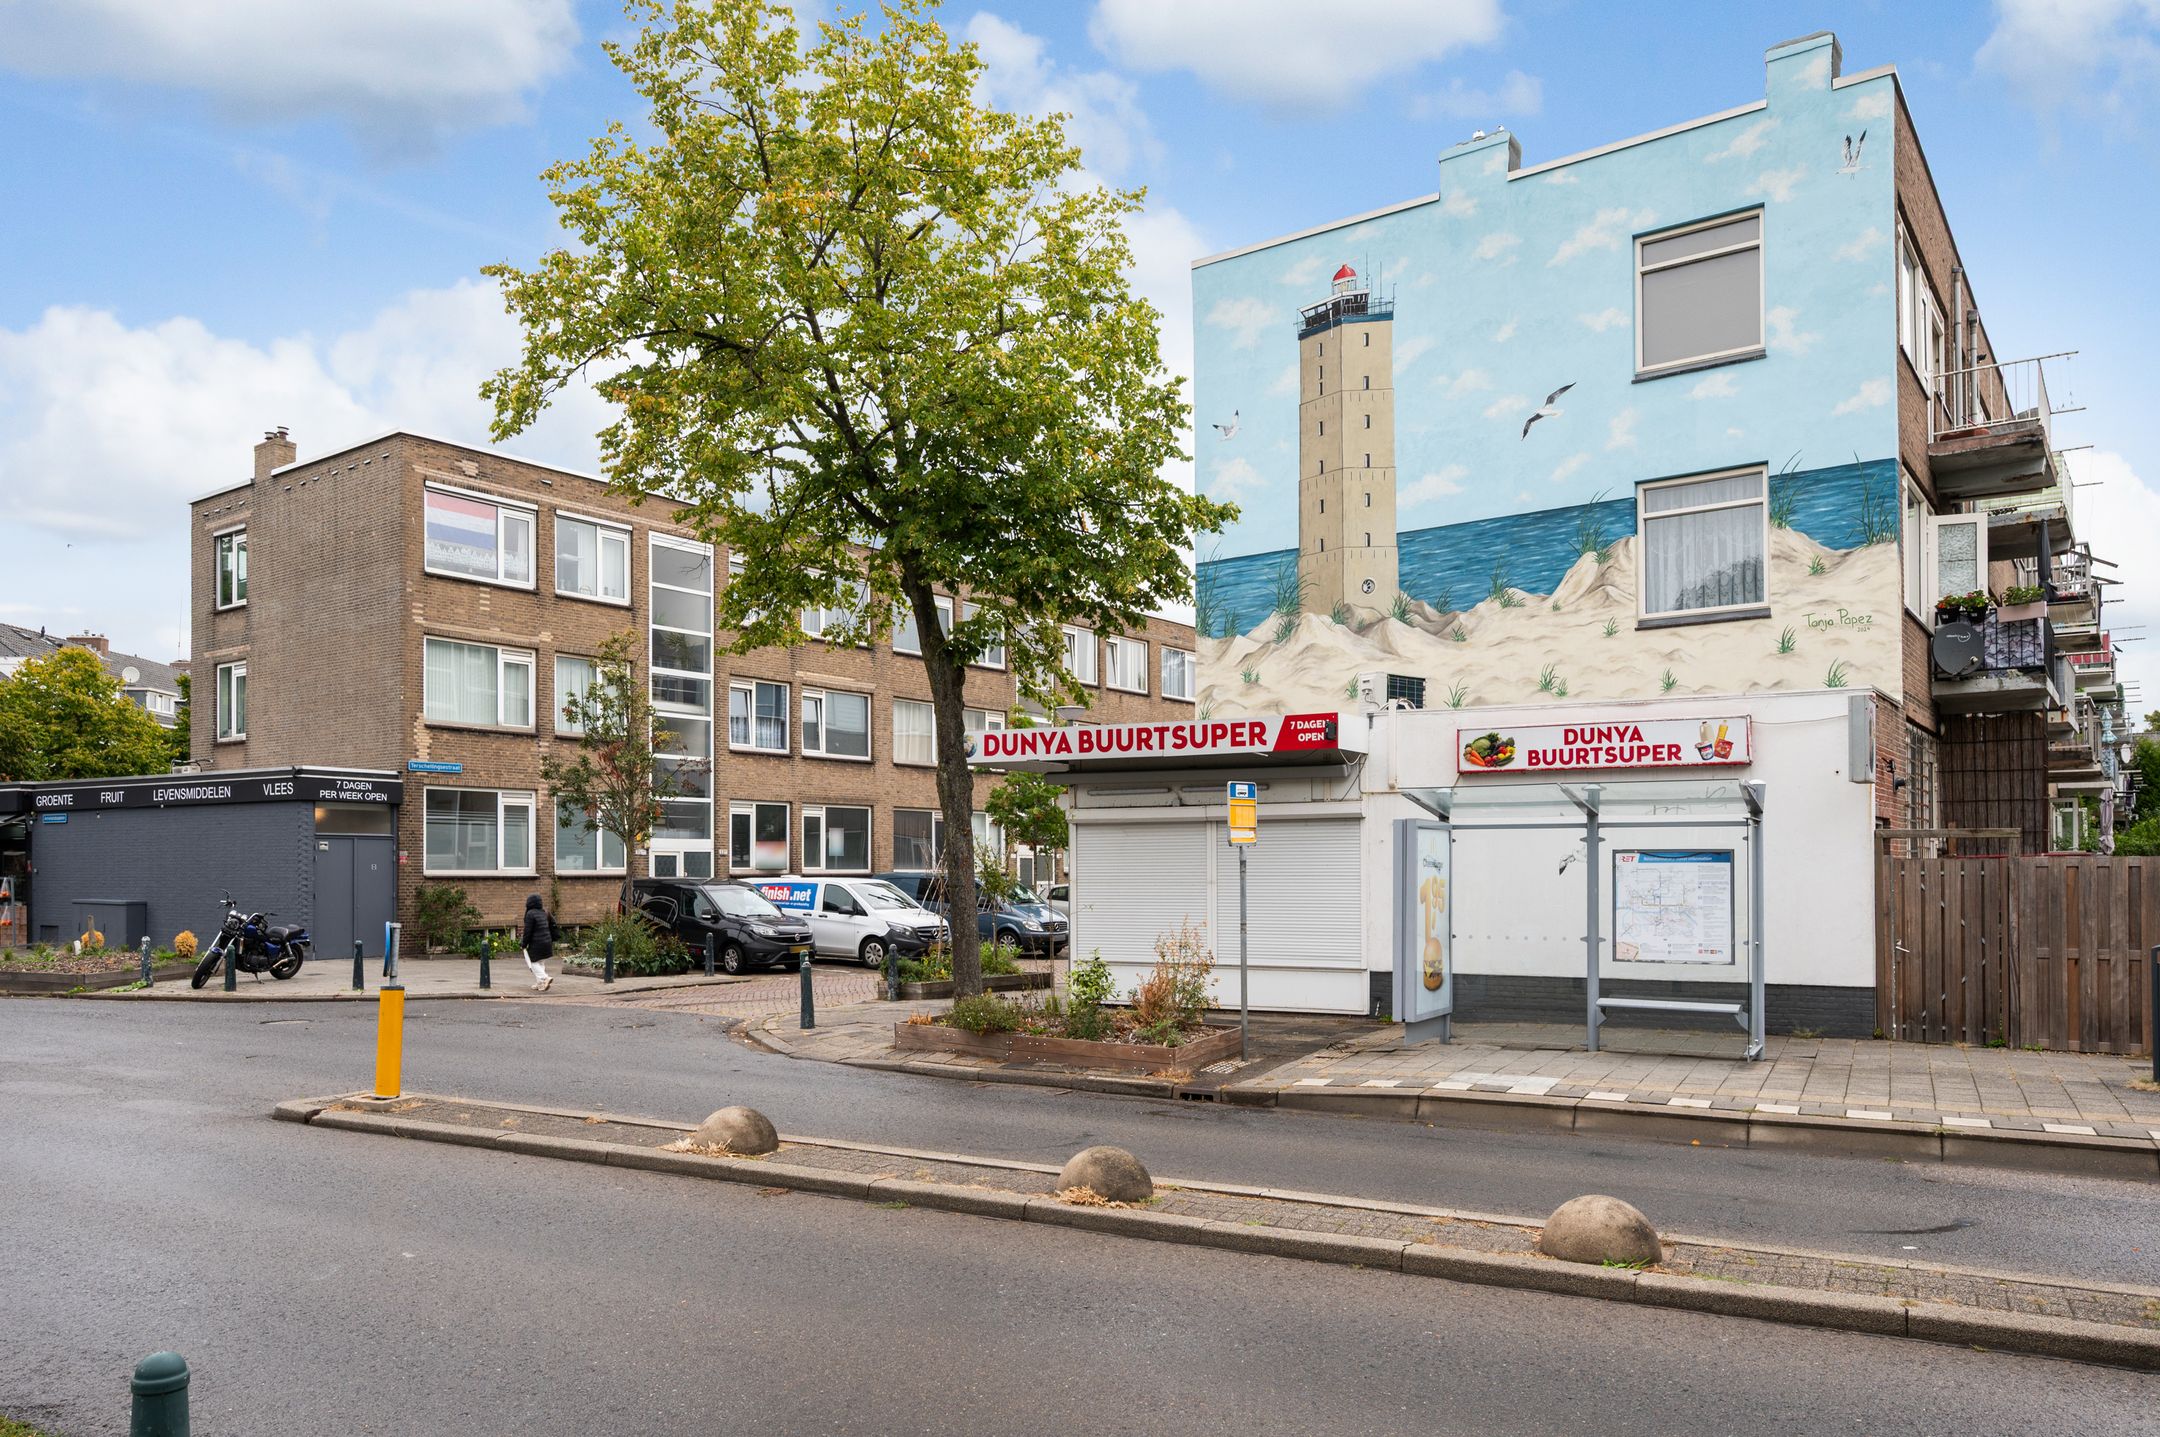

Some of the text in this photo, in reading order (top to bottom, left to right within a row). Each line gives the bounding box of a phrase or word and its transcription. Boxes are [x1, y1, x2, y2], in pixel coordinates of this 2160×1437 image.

[1802, 608, 1873, 632] Tanja Papez
[1290, 721, 1296, 730] 7
[984, 721, 1268, 757] DUNYA BUURTSUPER
[1298, 732, 1325, 742] OPEN
[1564, 725, 1644, 745] DUNYA
[1527, 744, 1682, 766] BUURTSUPER
[411, 763, 460, 771] Terschellingsestraat
[262, 782, 294, 796] VLEES
[336, 780, 373, 791] 7 DAGEN
[36, 793, 74, 807] GROENTE
[100, 790, 125, 804] FRUIT
[153, 785, 232, 801] LEVENSMIDDELEN
[319, 790, 389, 801] PER WEEK OPEN
[1620, 855, 1635, 863] RET
[370, 863, 378, 871] 8
